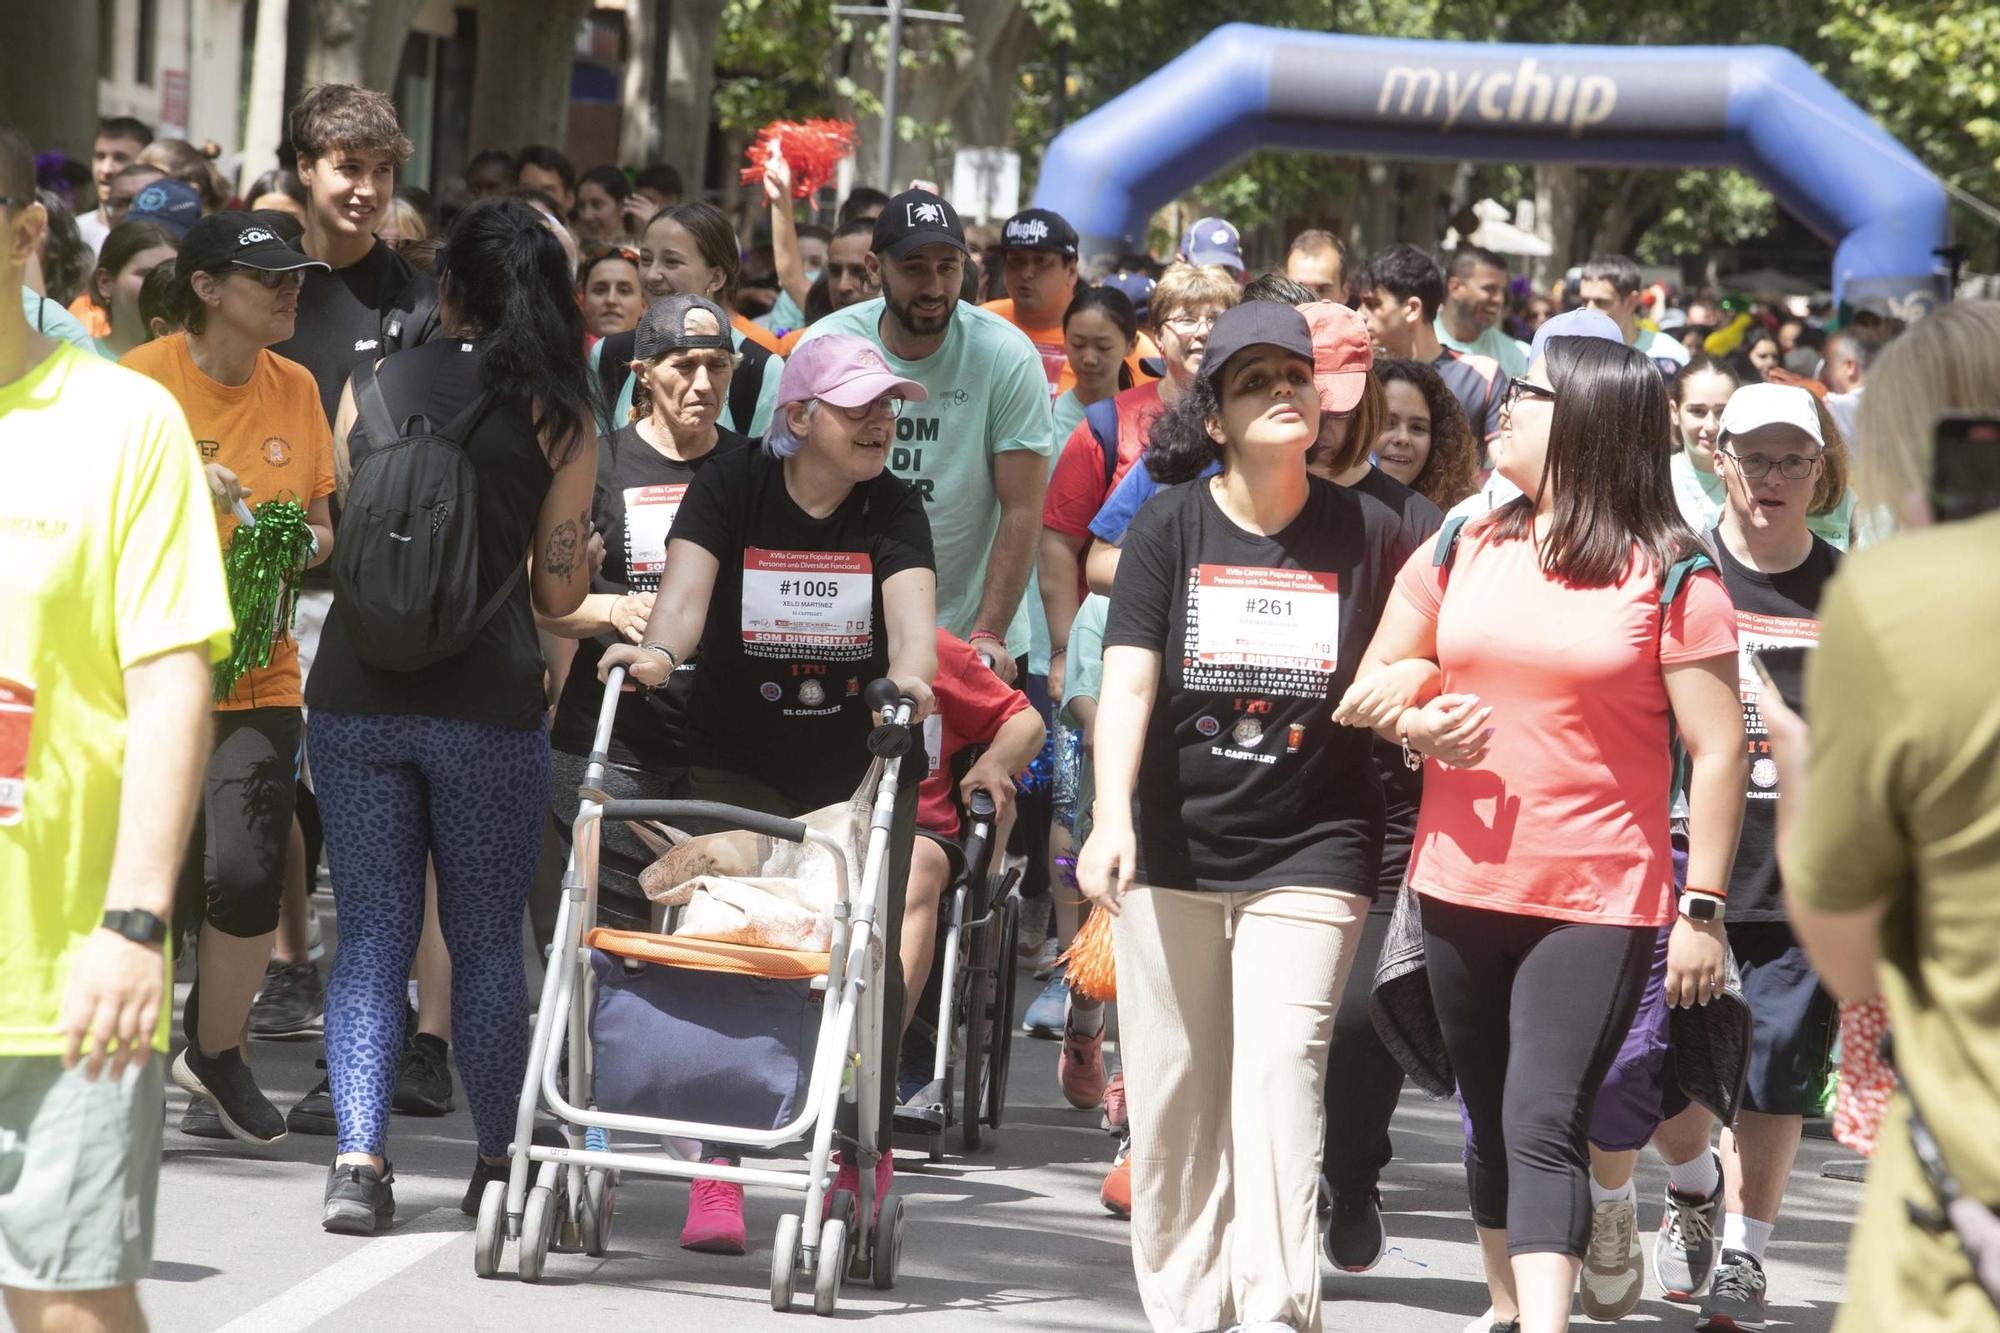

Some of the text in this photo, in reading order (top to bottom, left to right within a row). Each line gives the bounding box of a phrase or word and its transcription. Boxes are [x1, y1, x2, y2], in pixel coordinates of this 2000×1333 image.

[1376, 57, 1618, 139] mychip
[896, 417, 940, 441] OM
[758, 560, 787, 568] Persones
[780, 580, 838, 597] #1005
[1246, 598, 1292, 616] #261
[755, 633, 857, 644] SOM DIVERSITAT
[795, 705, 842, 716] CASTELLET
[1211, 746, 1224, 756] EL
[1224, 749, 1277, 764] CASTELLET
[1759, 740, 1770, 753] T
